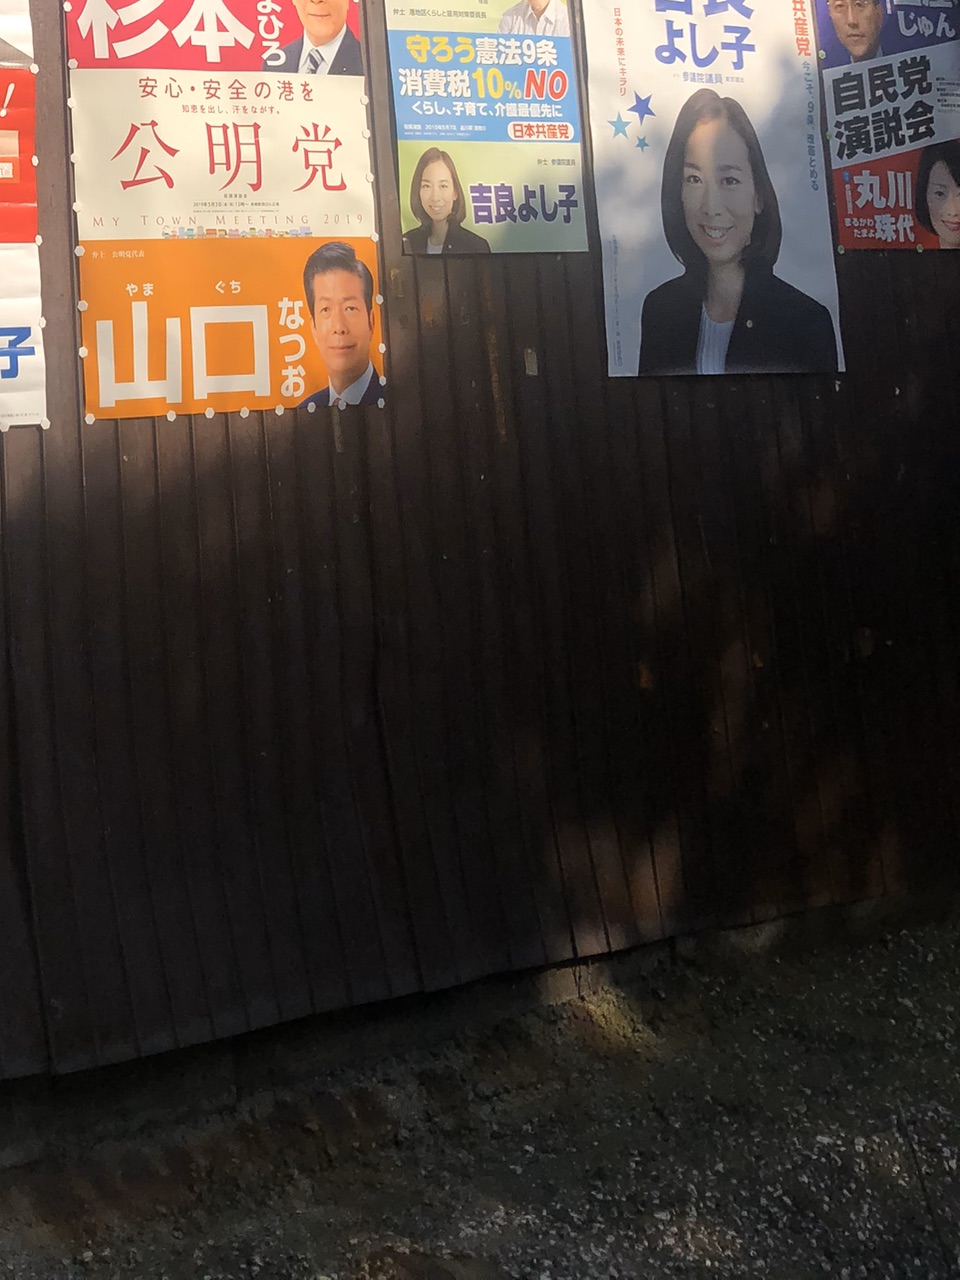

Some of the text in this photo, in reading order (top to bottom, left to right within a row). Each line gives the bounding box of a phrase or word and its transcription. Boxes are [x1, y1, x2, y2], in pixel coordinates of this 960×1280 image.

[897, 10, 956, 38] じゅん
[406, 35, 558, 67] 守ろう憲法9条
[613, 7, 627, 97] 日本の未来にキラリ
[654, 19, 756, 71] よし子
[138, 76, 314, 101] 安心・安全の港を
[683, 71, 723, 84] 参議院議員
[831, 55, 933, 116] 自民党
[411, 101, 563, 118] くらし、子育て、介護最優先に
[512, 124, 570, 139] 日本共産党
[834, 100, 936, 160] 演説会
[110, 119, 348, 192] 公明党
[469, 183, 579, 224] 吉良よし子
[853, 170, 913, 210] 丸川
[93, 216, 121, 227] MY
[324, 214, 364, 225] 2019
[854, 228, 875, 238] たまよ
[874, 214, 915, 242] 珠代
[126, 280, 241, 297] やま ぐち
[96, 300, 271, 408] 山口
[278, 297, 307, 398] なつお
